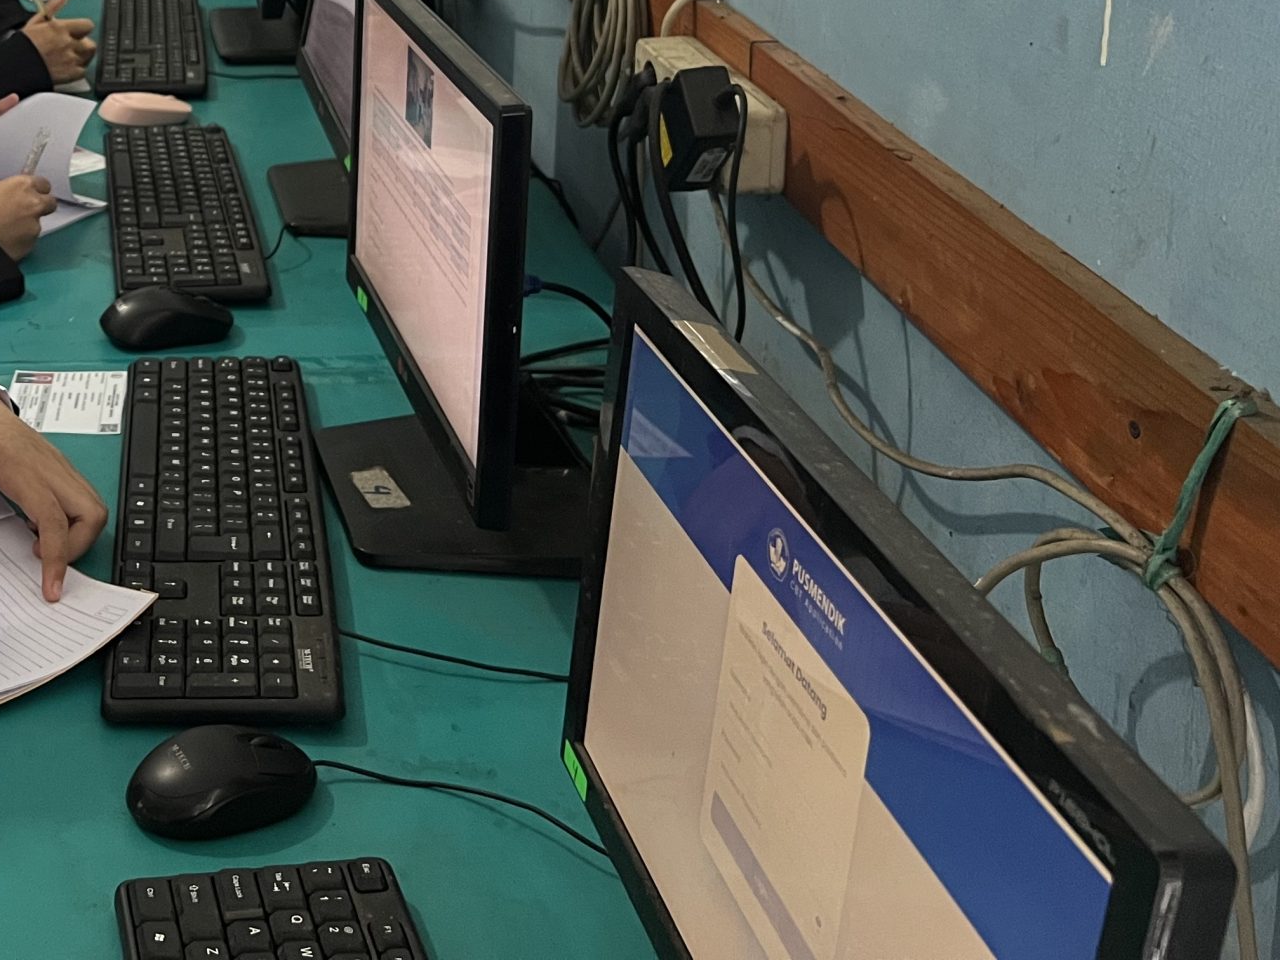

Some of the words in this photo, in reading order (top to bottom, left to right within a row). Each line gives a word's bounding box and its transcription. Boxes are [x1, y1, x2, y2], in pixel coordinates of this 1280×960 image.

[792, 558, 847, 635] PUSMENDIK
[762, 621, 796, 674] Selamat
[795, 666, 828, 722] Datang
[291, 915, 303, 924] Q
[248, 926, 262, 936] A
[206, 947, 219, 956] Z
[300, 947, 314, 958] W
